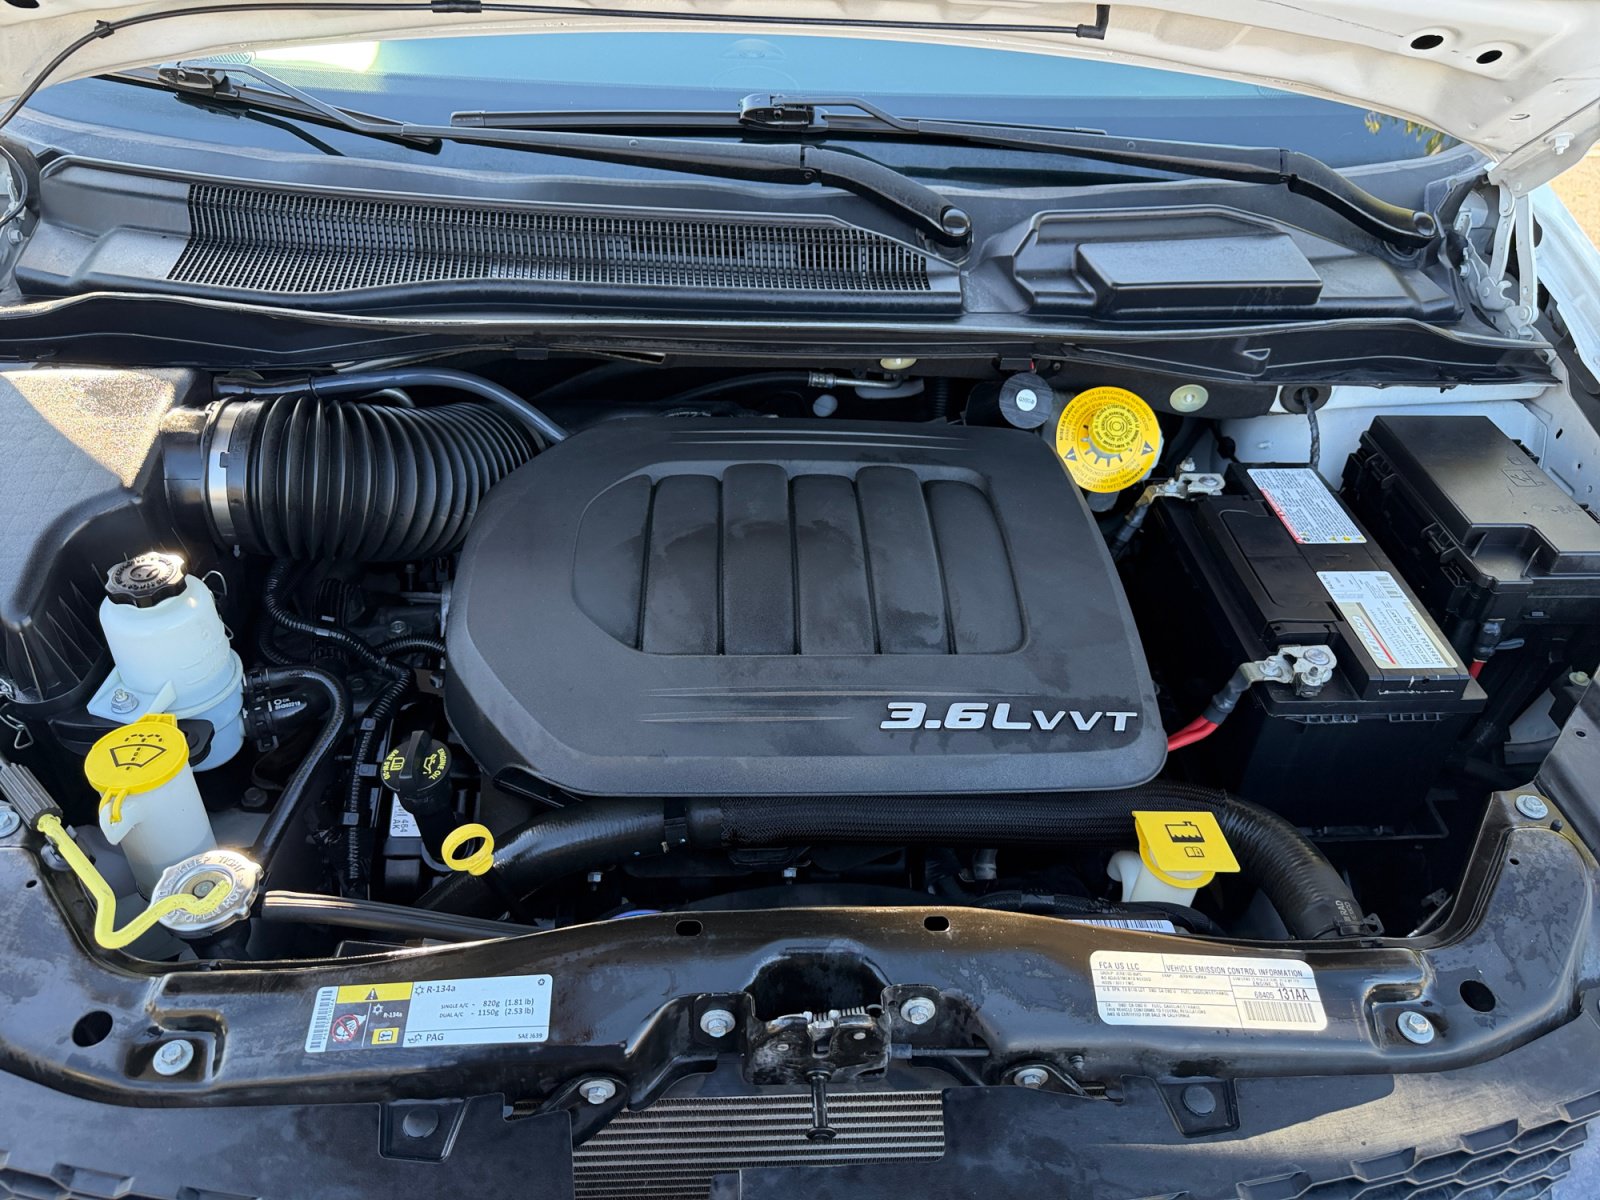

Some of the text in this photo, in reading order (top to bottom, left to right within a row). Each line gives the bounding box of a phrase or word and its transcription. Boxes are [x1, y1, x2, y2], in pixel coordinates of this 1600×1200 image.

[386, 749, 399, 761] SAE
[428, 748, 447, 780] ENGINE OIL
[392, 819, 400, 830] AK
[1098, 960, 1140, 970] FCA US LLC
[1165, 963, 1304, 977] VEHICLE EMISSION CONTROL INFORMATION
[426, 985, 456, 994] R-134a
[1277, 987, 1310, 1001] 131AA
[482, 1000, 501, 1008] 820g
[504, 998, 523, 1007] (1.81
[524, 997, 534, 1006] lb)
[478, 1009, 500, 1017] 1150g
[504, 1007, 523, 1017] (2.53
[524, 1006, 534, 1016] lb)
[426, 1033, 445, 1041] PAG
